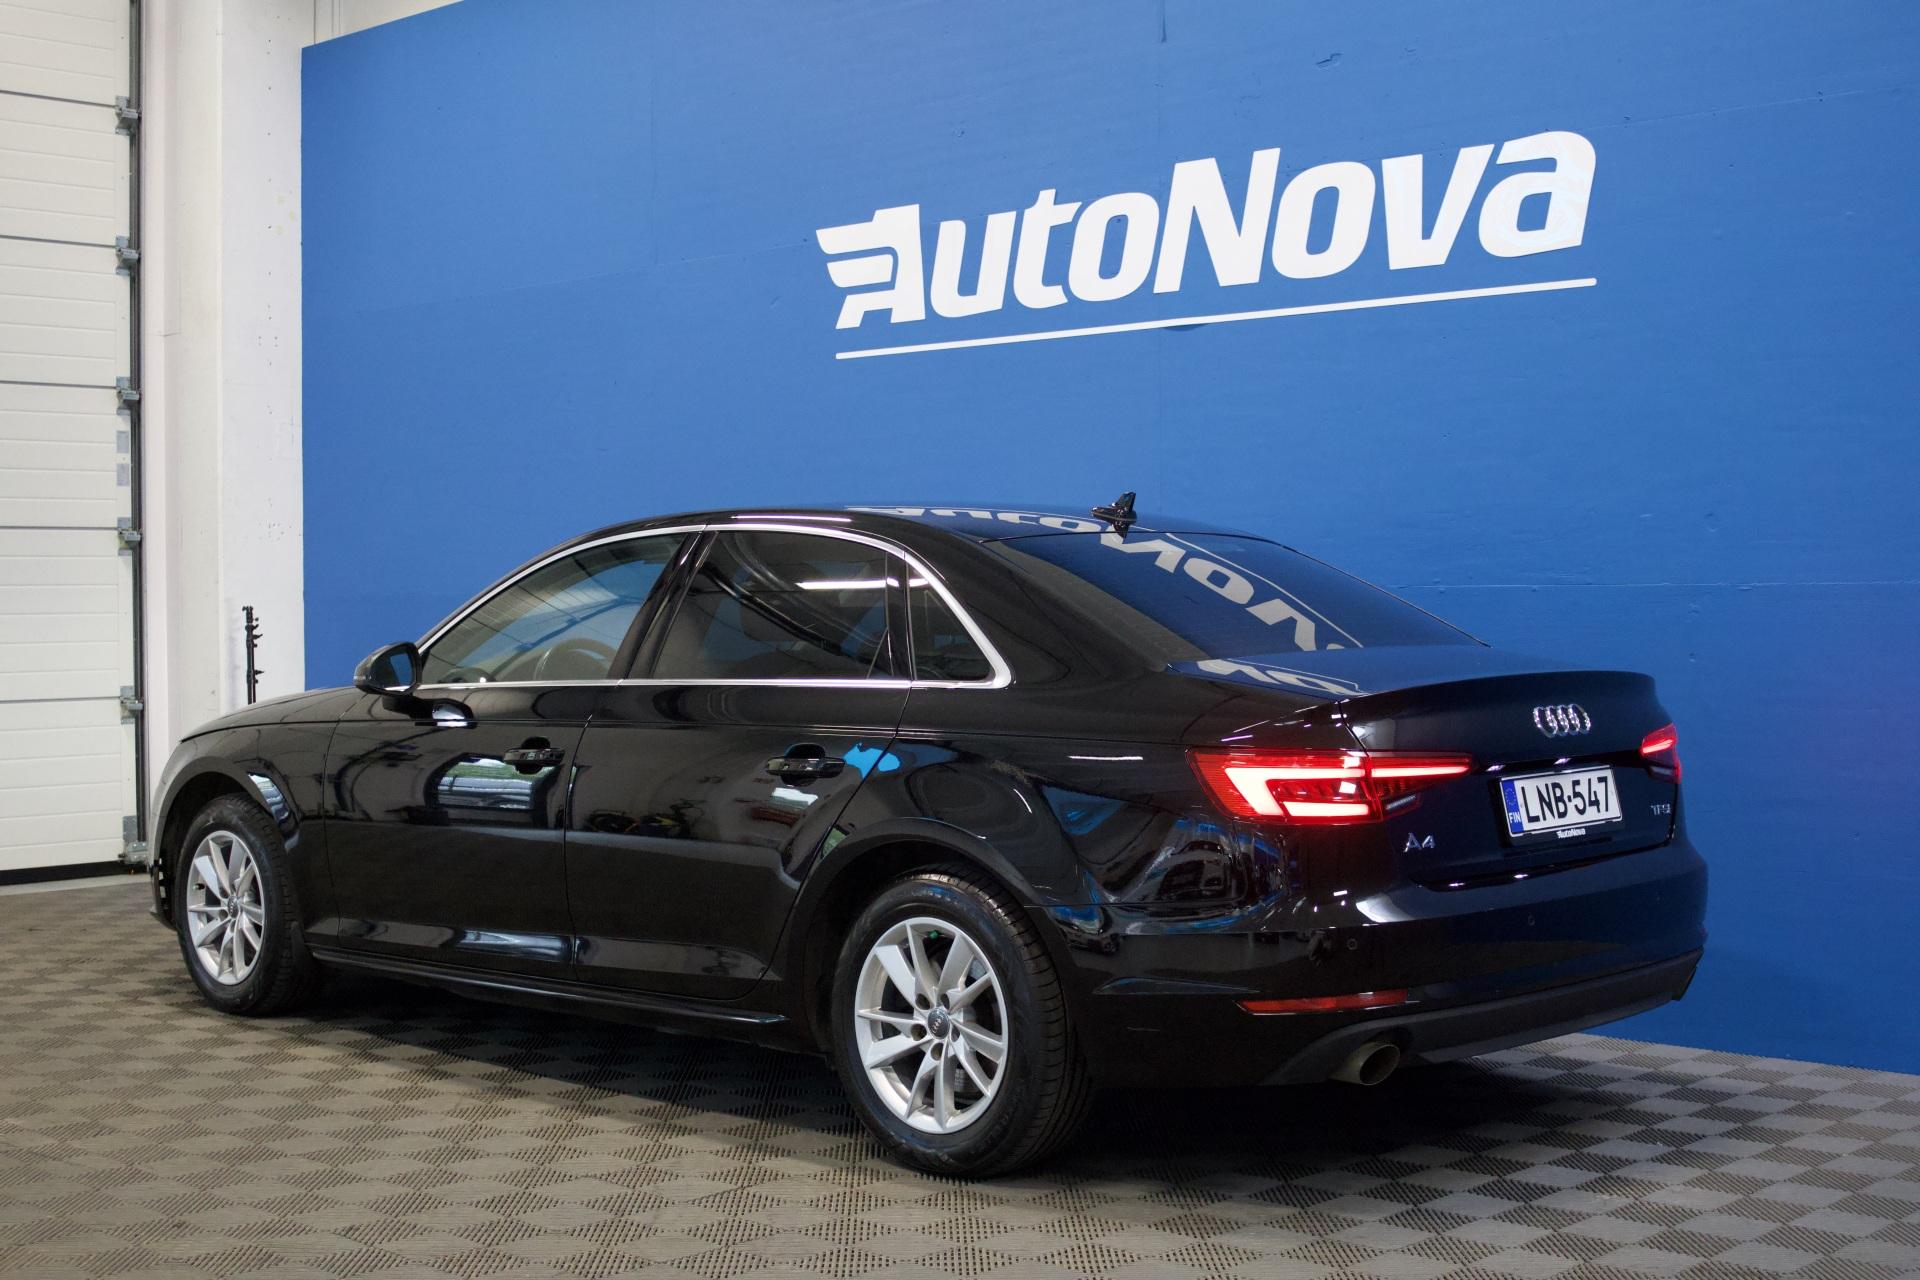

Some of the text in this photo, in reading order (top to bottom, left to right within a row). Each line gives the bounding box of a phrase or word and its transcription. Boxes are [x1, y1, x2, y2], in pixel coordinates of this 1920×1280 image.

[816, 131, 1596, 330] AutoNova
[1521, 776, 1609, 823] LNB-547
[1508, 812, 1521, 824] FIN
[1403, 832, 1435, 853] A4
[1556, 828, 1586, 839] AutoNova
